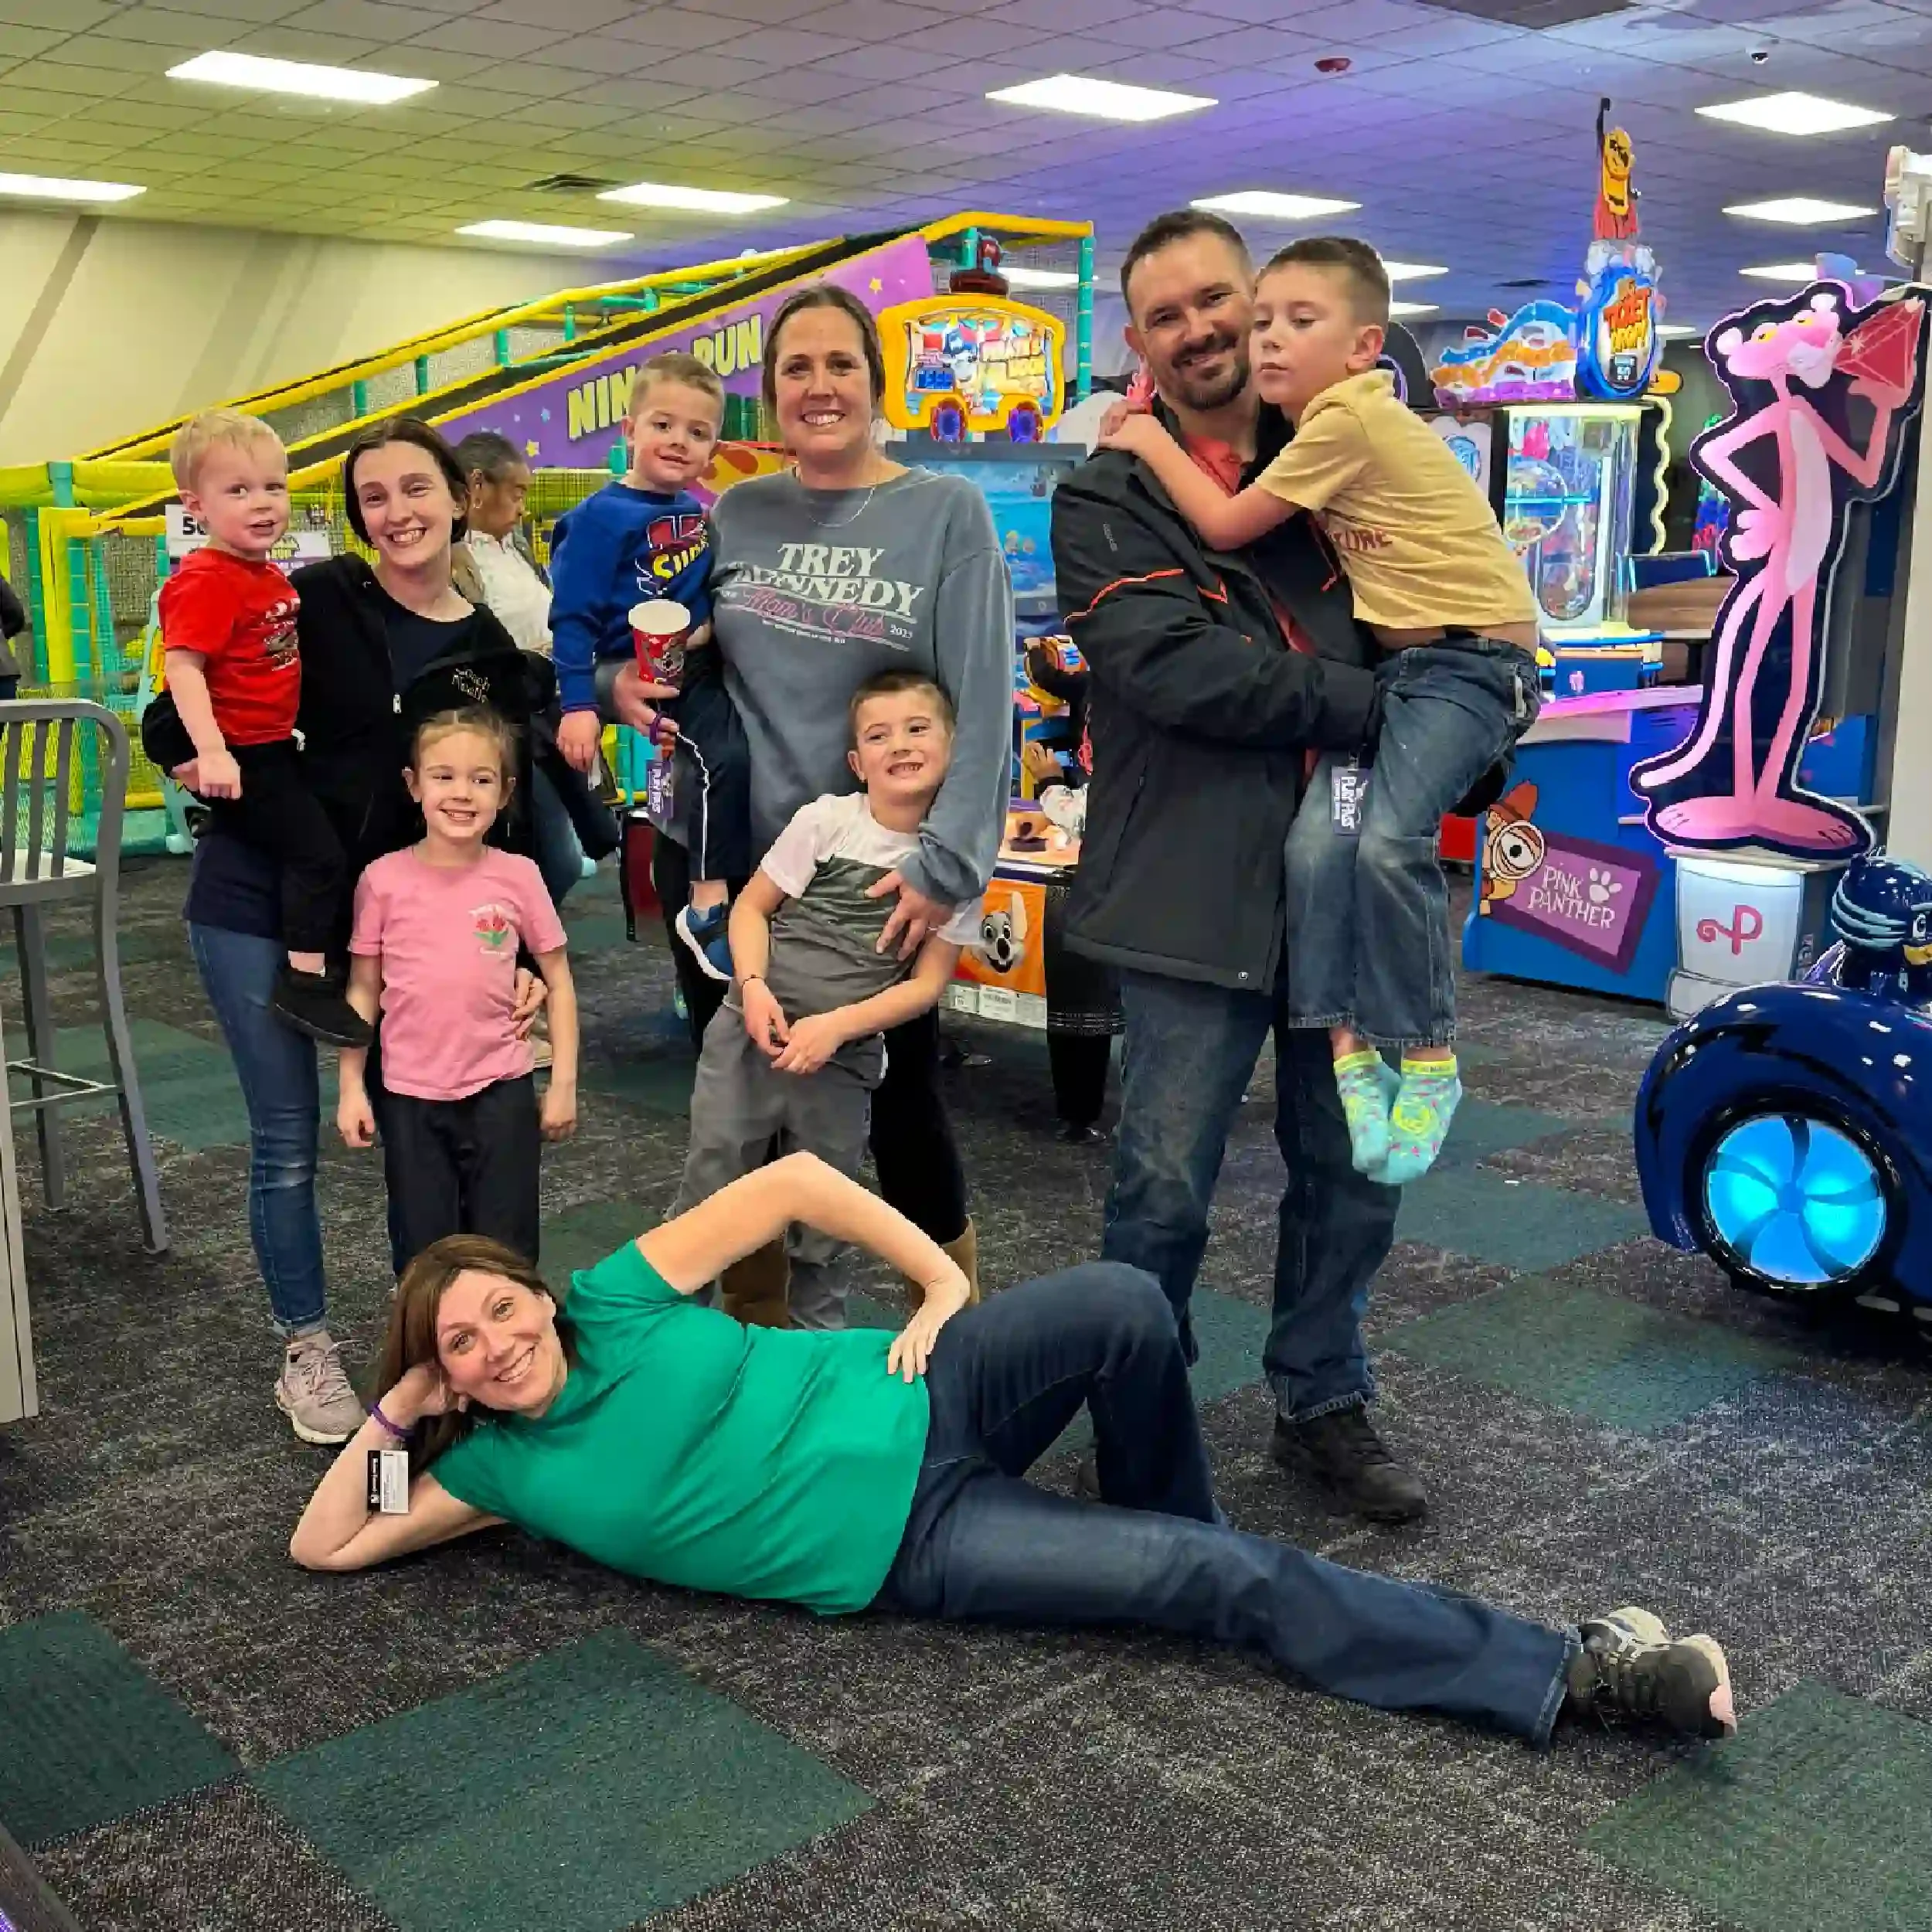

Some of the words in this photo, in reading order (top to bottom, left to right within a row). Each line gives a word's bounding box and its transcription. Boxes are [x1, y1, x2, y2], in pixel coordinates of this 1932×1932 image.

[693, 313, 763, 376] RUN
[777, 543, 886, 577] TREY
[1542, 865, 1583, 900] PINK
[1527, 886, 1616, 929] PANTHER
